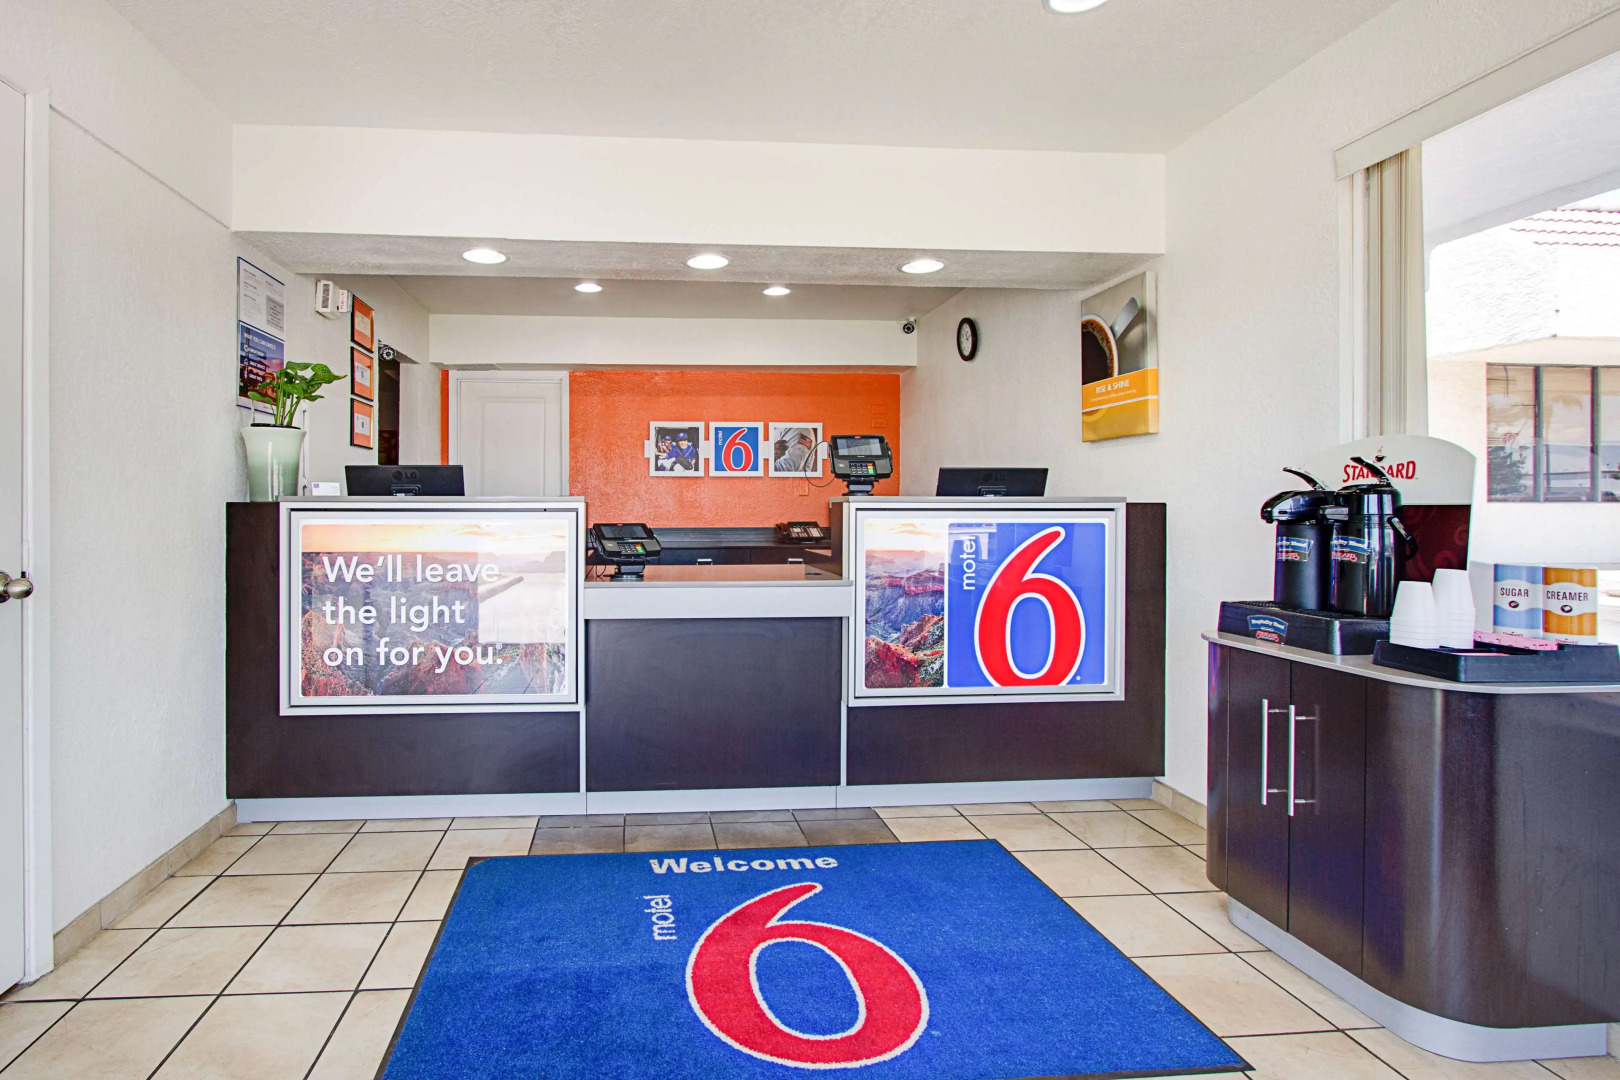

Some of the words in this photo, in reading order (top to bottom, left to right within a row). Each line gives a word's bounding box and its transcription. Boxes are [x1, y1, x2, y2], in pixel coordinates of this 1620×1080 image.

[1113, 379, 1129, 389] SHINE
[722, 428, 753, 471] 6
[405, 471, 417, 480] LG
[1342, 460, 1417, 483] STANARD
[322, 554, 403, 583] We'll
[416, 554, 500, 583] leave
[959, 536, 976, 591] motel
[974, 526, 1086, 687] 6
[1500, 587, 1529, 598] SUGAR
[1546, 590, 1589, 602] CREAMER
[322, 596, 377, 625] the
[390, 596, 466, 632] light
[322, 645, 364, 667] on
[376, 637, 425, 666] for
[649, 856, 839, 875] Welcome
[644, 894, 678, 941] motel
[686, 881, 931, 1070] 6
